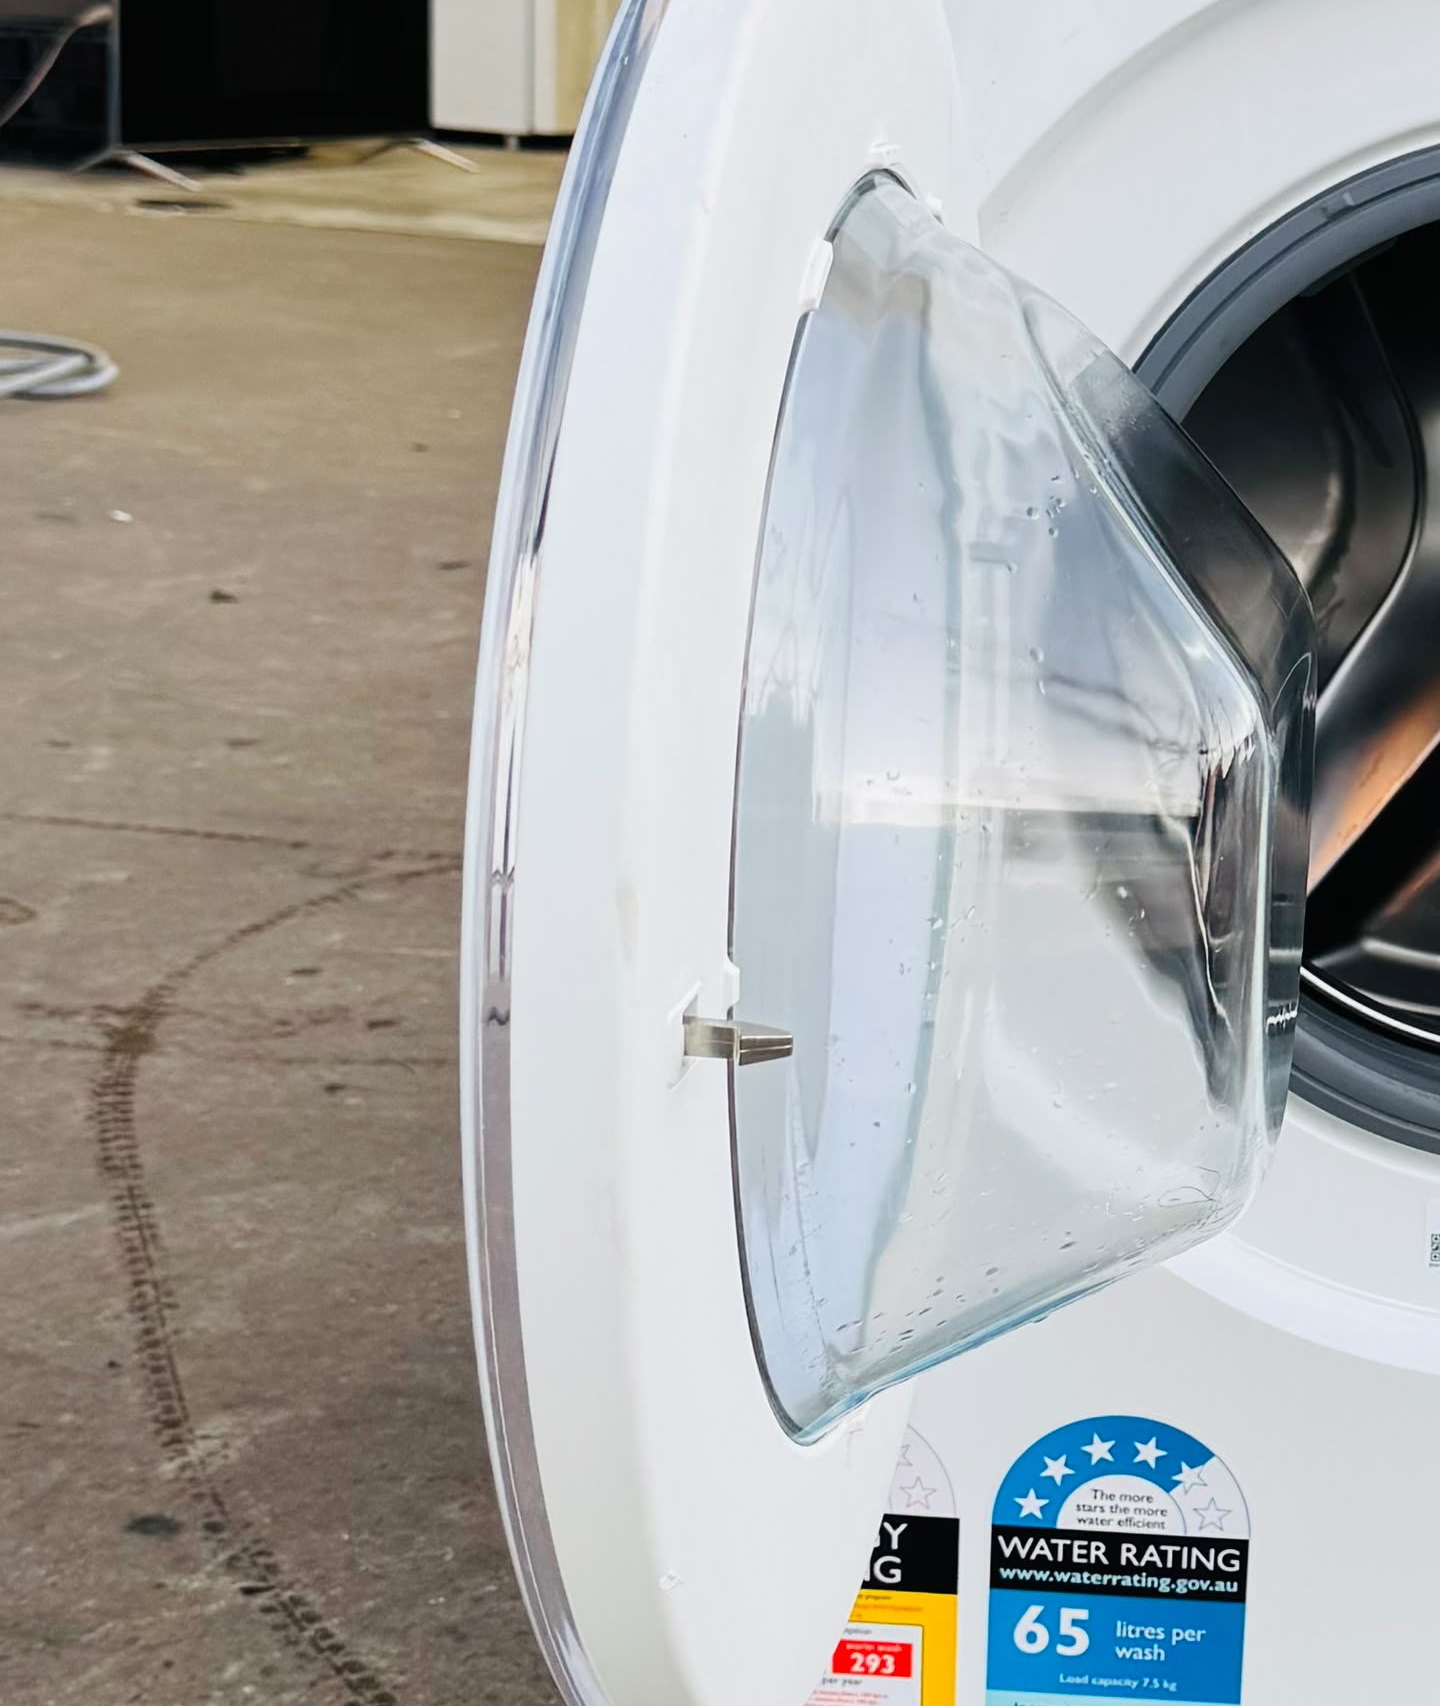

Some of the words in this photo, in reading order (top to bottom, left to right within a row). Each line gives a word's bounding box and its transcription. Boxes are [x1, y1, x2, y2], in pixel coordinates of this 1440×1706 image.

[1091, 1488, 1116, 1501] The
[1119, 1492, 1154, 1504] more
[1075, 1503, 1106, 1513] stars
[1109, 1503, 1130, 1514] the
[1133, 1506, 1169, 1517] more
[1076, 1516, 1115, 1526] water
[1117, 1516, 1166, 1530] efficient
[997, 1535, 1110, 1565] WATER
[1120, 1543, 1241, 1572] RATING
[998, 1566, 1239, 1593] www.waterrating.gov.au
[1013, 1604, 1090, 1656] 65
[1115, 1620, 1165, 1640] litres
[1171, 1626, 1206, 1645] per
[1115, 1643, 1166, 1661] wash
[850, 1652, 896, 1675] 293
[1059, 1672, 1089, 1685] Load
[1091, 1675, 1139, 1689] capacity
